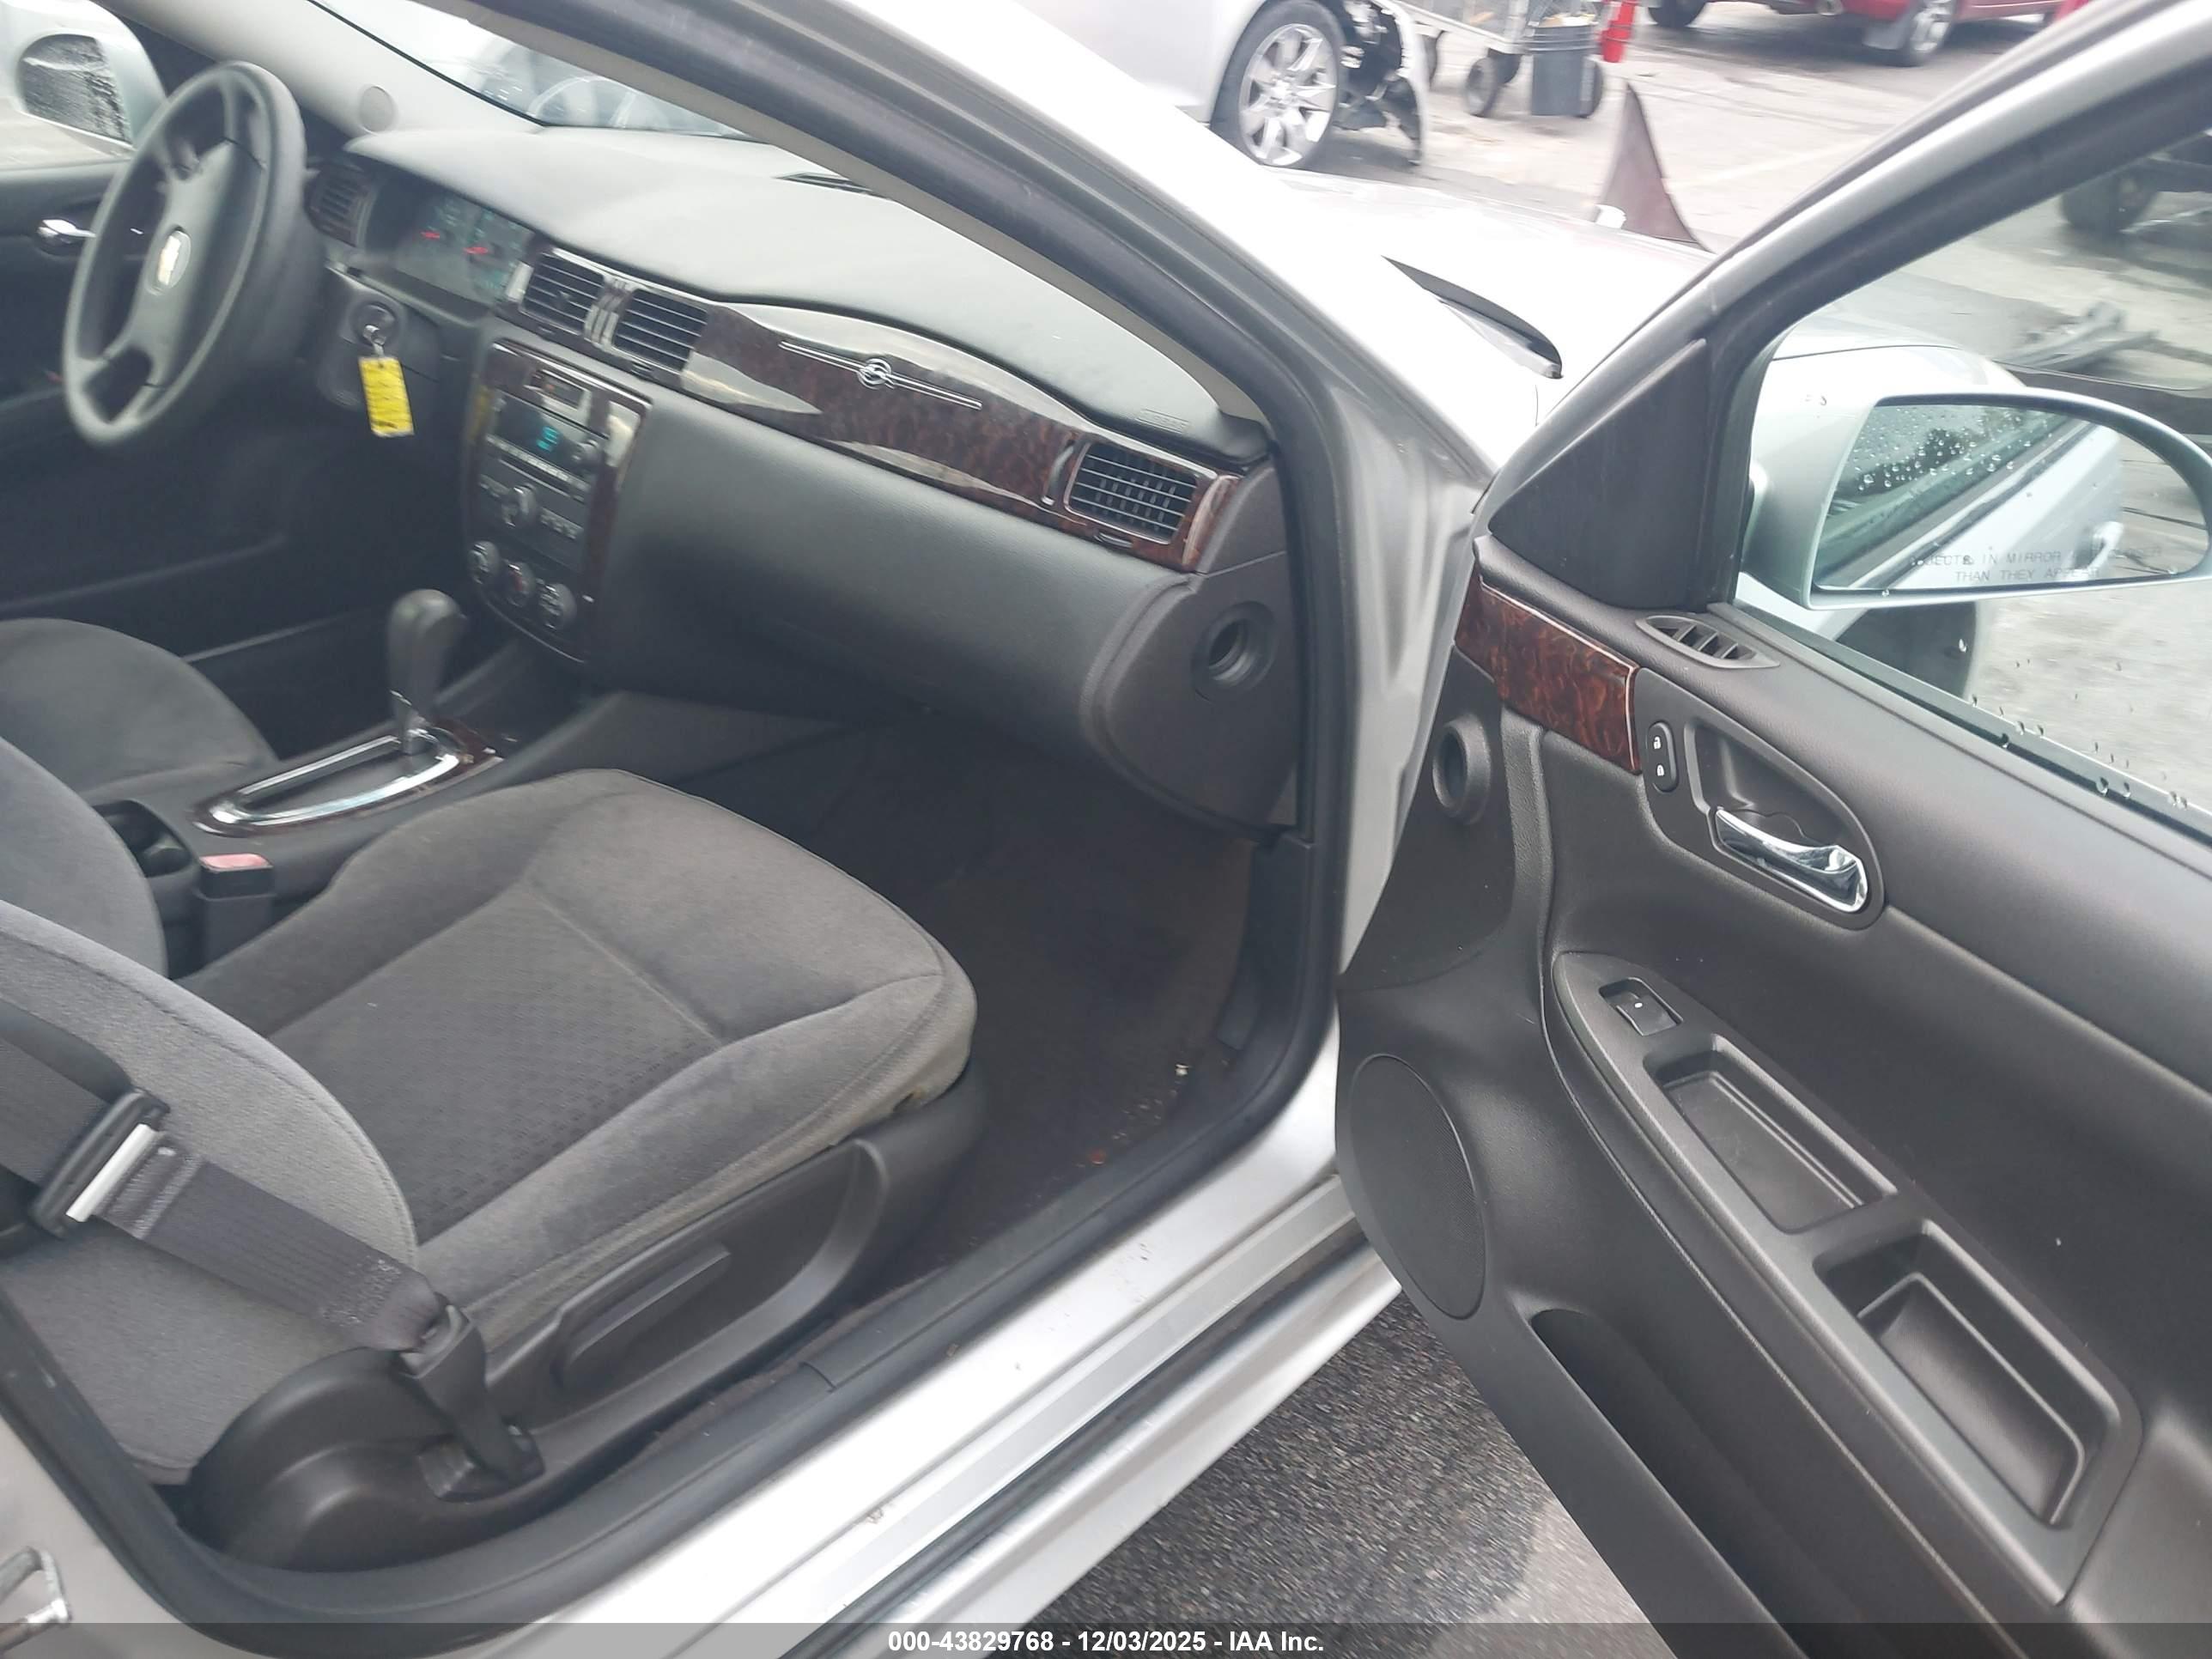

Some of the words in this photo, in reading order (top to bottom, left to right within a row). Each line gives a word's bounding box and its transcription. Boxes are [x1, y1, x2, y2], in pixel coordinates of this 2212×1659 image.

[2007, 550, 2062, 563] MIRROR
[1955, 569, 1990, 582] THAN
[1999, 568, 2035, 581] THEY
